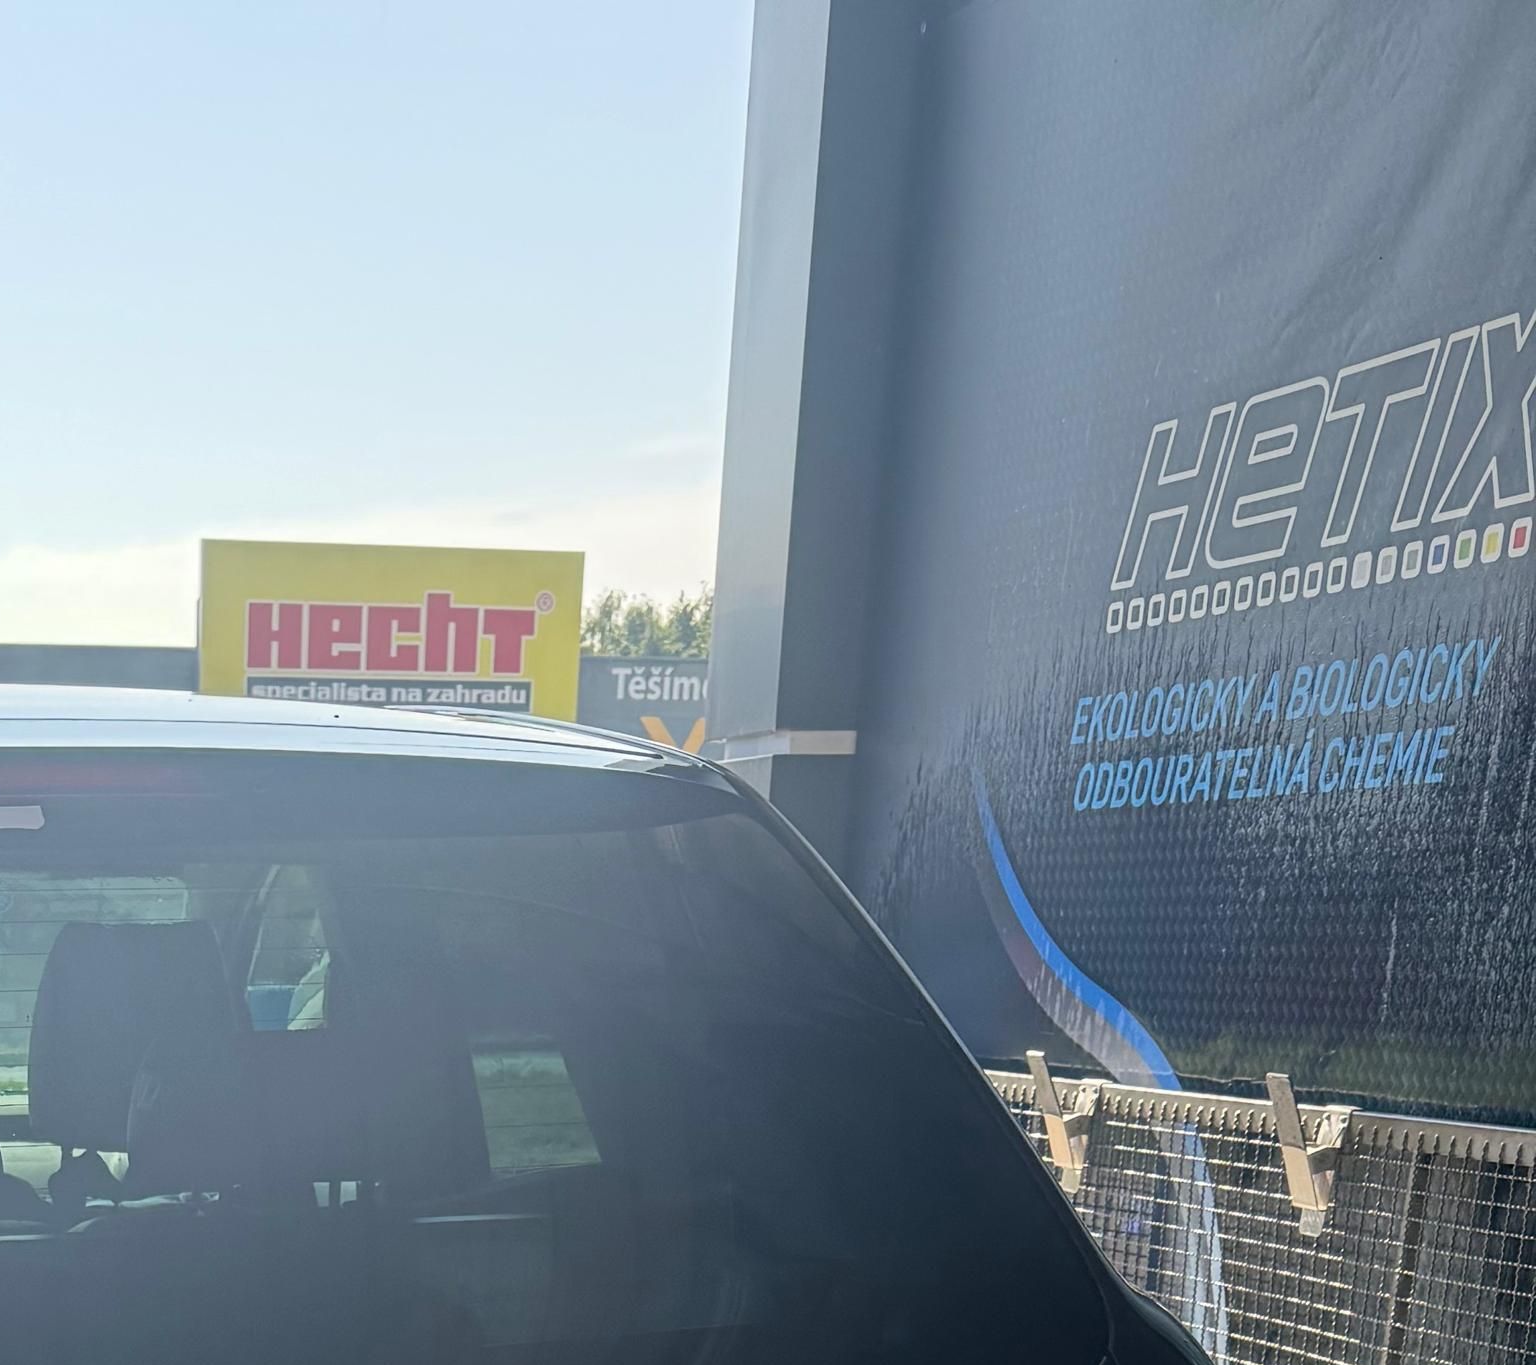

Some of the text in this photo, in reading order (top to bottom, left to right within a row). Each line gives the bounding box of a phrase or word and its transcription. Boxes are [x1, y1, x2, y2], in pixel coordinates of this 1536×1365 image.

[391, 687, 423, 703] na
[426, 684, 527, 705] zahradu
[1070, 635, 1502, 745] EKOLOGICKY A BIOLOGICKY
[1073, 726, 1455, 812] ODBOURATELNÁ CHEMIE
